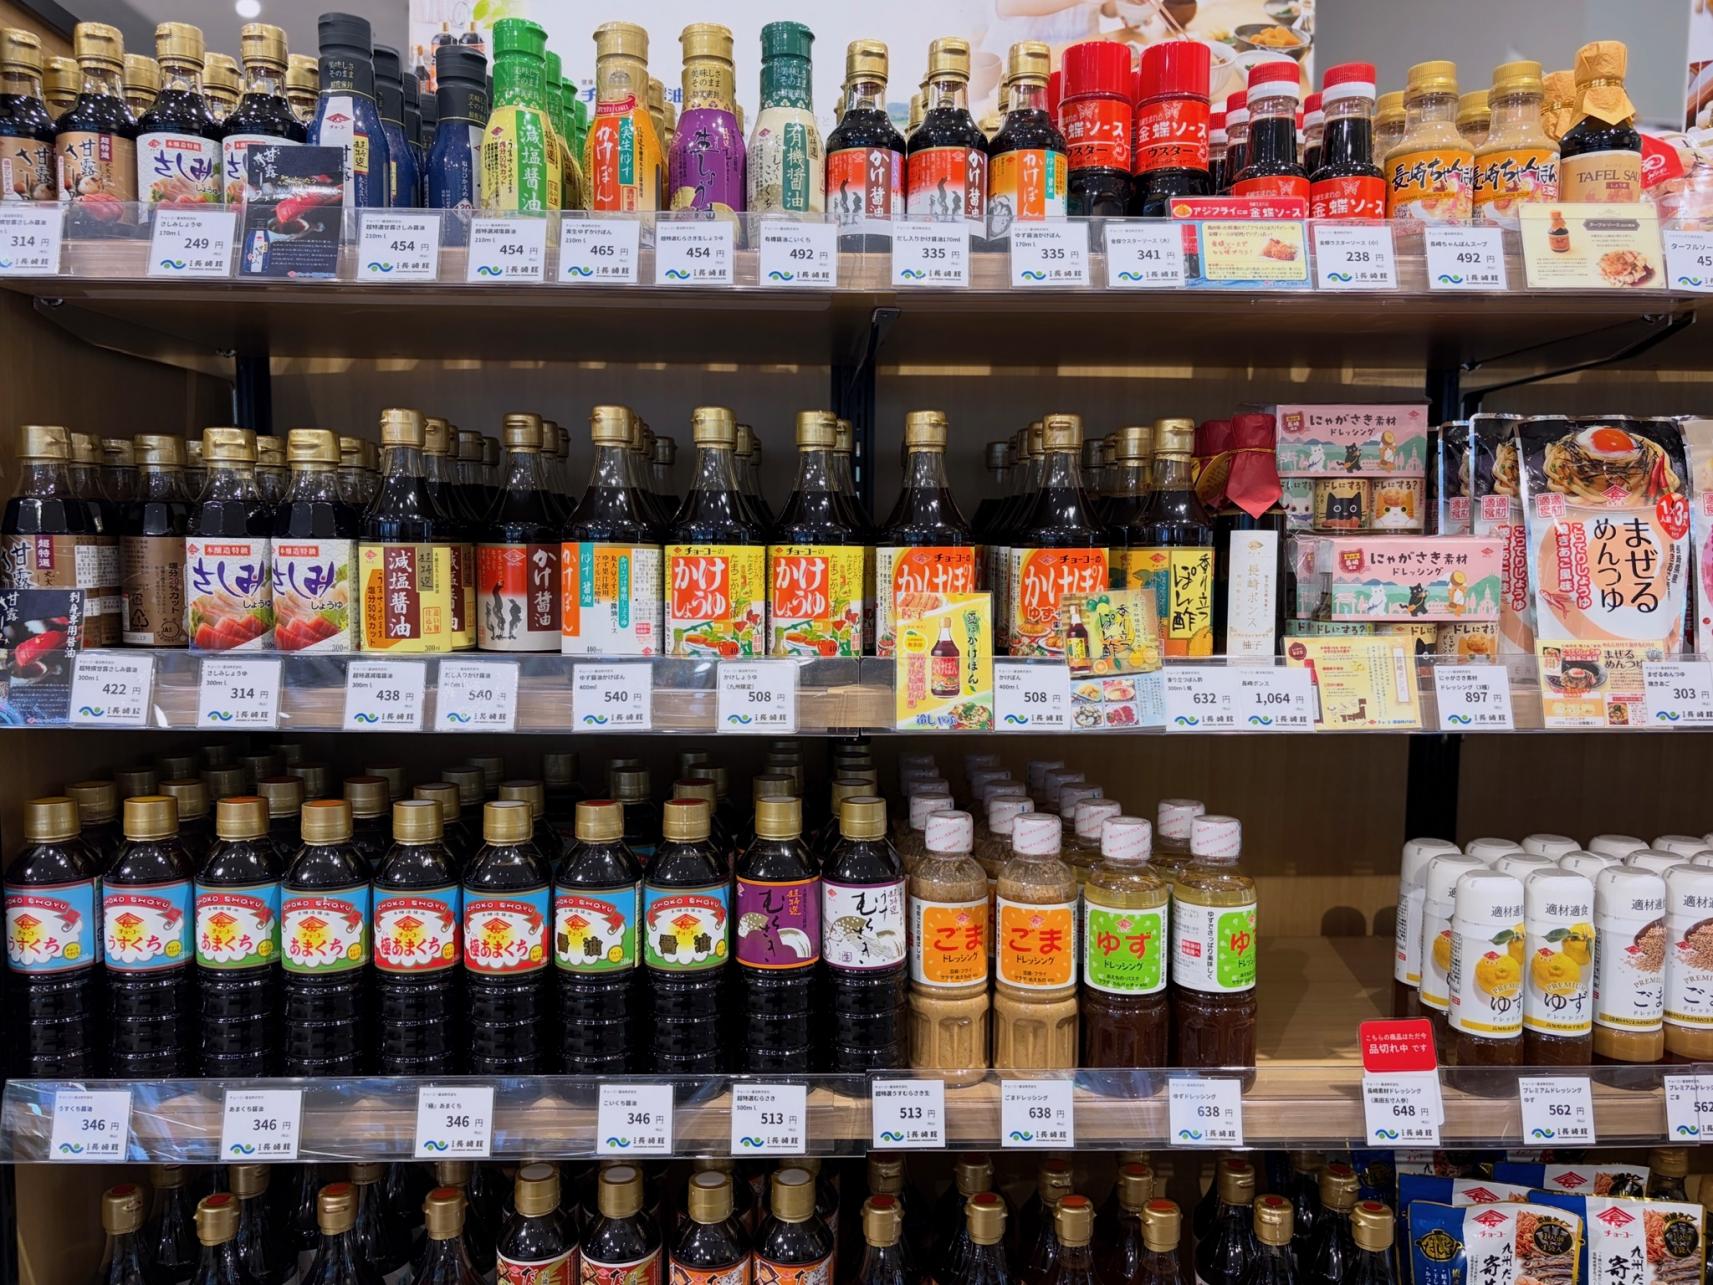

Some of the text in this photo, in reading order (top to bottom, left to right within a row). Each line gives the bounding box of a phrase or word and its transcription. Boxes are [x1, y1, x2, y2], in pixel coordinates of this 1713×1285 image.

[692, 78, 720, 87] そのまま
[1138, 122, 1207, 141] 金蝶ソース
[1147, 146, 1194, 156] ウスター
[154, 149, 212, 182] さしみ
[521, 125, 542, 211] 減塩醤油
[786, 124, 806, 208] 有機醤油
[1577, 170, 1620, 183] TAFEL
[869, 152, 889, 217] かけ醤油
[968, 152, 984, 217] かけ醤油
[1023, 153, 1042, 217] かけぽん
[1251, 207, 1301, 218] 金蝶ソース
[11, 236, 35, 246] 314
[184, 238, 209, 249] 249
[391, 241, 415, 251] 454
[500, 245, 523, 255] 454
[590, 246, 614, 256] 465
[686, 248, 710, 258] 454
[790, 249, 813, 259] 492
[922, 248, 945, 258] 335
[1042, 249, 1064, 259] 335
[1138, 250, 1160, 260] 341
[1346, 252, 1369, 261] 238
[1457, 253, 1480, 263] 492
[1310, 414, 1397, 426] にゃがさき素材
[1330, 428, 1375, 436] ドレッシング
[684, 547, 724, 555] チョーコーの
[786, 547, 826, 555] チョーコーの
[1059, 554, 1101, 564] チョーコーの
[1370, 552, 1468, 565] にゃがさき素材
[1594, 518, 1624, 613] めんつゆ
[1624, 518, 1659, 613] まぜる
[192, 557, 265, 597] さしみ
[674, 558, 726, 588] かけ
[776, 558, 827, 588] かけ
[1392, 567, 1444, 576] ドレッシング
[273, 561, 336, 599] さしみ
[532, 548, 556, 627] かけ醤油
[390, 551, 412, 638] 減塩醤油
[1172, 564, 1197, 631] ぽん酢
[243, 600, 272, 609] しょうゆ
[311, 601, 343, 610] しょうゆ
[674, 590, 726, 618] しょうゆ
[775, 590, 827, 618] しょうゆ
[102, 684, 141, 695] 422 円
[231, 688, 269, 699] 314 円
[1674, 688, 1709, 699] 303 円
[376, 690, 414, 701] 438 円
[604, 691, 642, 702] 540 円
[748, 691, 785, 702] 508 円
[1024, 692, 1047, 702] 508
[1193, 693, 1230, 704] 632 円
[1256, 693, 1304, 705] 1,064 円
[1465, 692, 1502, 702] 897 円
[131, 897, 168, 908] SHOYU
[222, 897, 261, 908] SHOYU
[411, 900, 445, 911] SHOYU
[500, 903, 533, 913] SHOYU
[579, 899, 612, 913] SHOYU
[690, 898, 720, 908] SHOYU
[1545, 903, 1589, 916] 適材適食
[201, 933, 253, 952] あまくち
[934, 924, 985, 952] ごま
[1008, 927, 1063, 955] ごま
[8, 937, 60, 954] うすくち
[108, 935, 162, 953] うすくち
[290, 937, 343, 957] あまくち
[381, 937, 441, 956] 極あまくち
[469, 938, 528, 958] 極あまくち
[1097, 931, 1152, 957] ゆず
[943, 952, 979, 963] ドレッシング
[1016, 956, 1055, 966] ドレッシング
[1103, 960, 1143, 971] ドレッシング
[1544, 991, 1589, 1014] ゆず
[1366, 1033, 1427, 1042] こちらの商品はただ今
[1369, 1044, 1427, 1054] 品切れ中 です
[1522, 1086, 1583, 1095] プレミアムドレッシング
[1004, 1094, 1049, 1102] ごまドレッシング
[1172, 1093, 1217, 1101] ゆずドレッシング
[900, 1107, 935, 1119] 513 円
[1029, 1107, 1064, 1118] 638 円
[1198, 1106, 1233, 1117] 638 円
[1393, 1105, 1429, 1116] 648 円
[1549, 1105, 1584, 1115] 562 円
[1694, 1101, 1713, 1115] 562
[446, 1116, 483, 1127] 346 円
[627, 1113, 664, 1124] 346 円
[761, 1113, 797, 1124] 513 円
[82, 1119, 119, 1131] 346 円
[253, 1119, 291, 1130] 346 円
